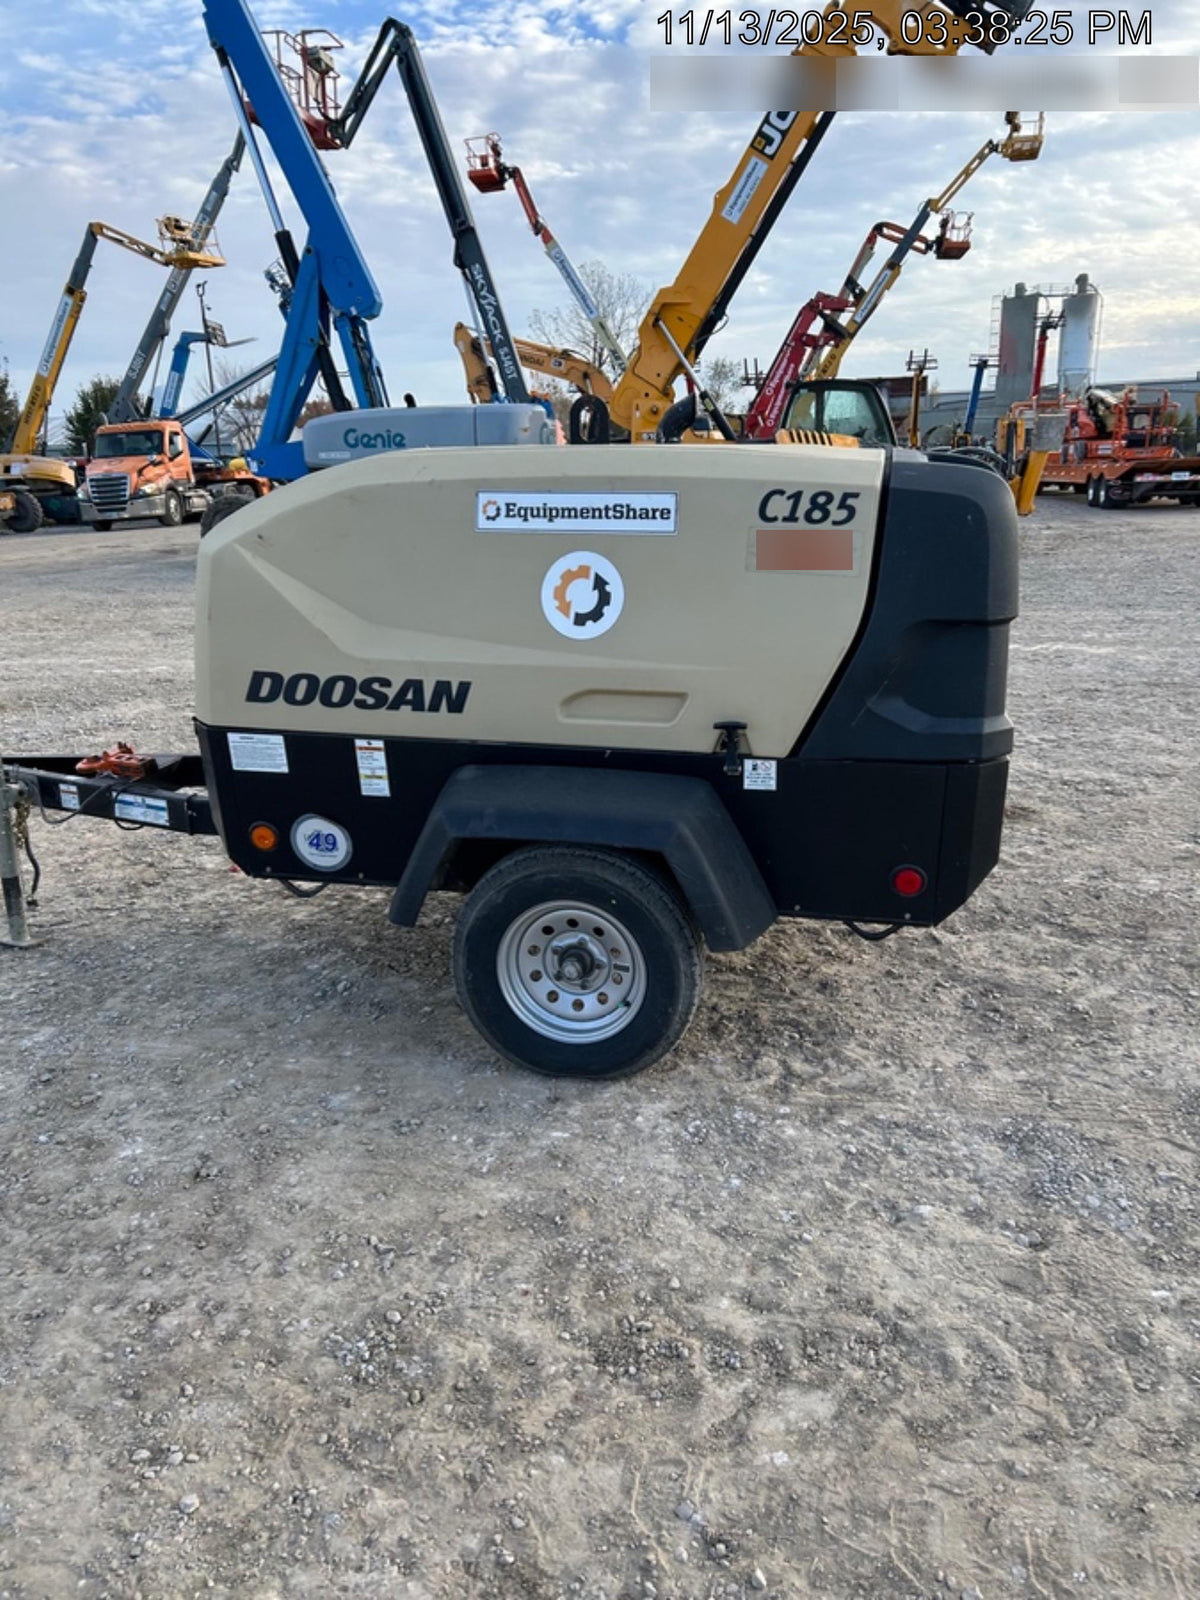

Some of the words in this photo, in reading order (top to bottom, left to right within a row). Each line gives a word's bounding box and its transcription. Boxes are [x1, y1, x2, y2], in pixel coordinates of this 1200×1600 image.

[762, 111, 798, 156] JC
[470, 264, 505, 341] SKYJACK
[343, 428, 407, 449] Genie
[504, 502, 671, 521] EquipmentShare
[757, 488, 860, 525] C185
[245, 670, 472, 714] DOOSAN
[308, 832, 338, 852] 49
